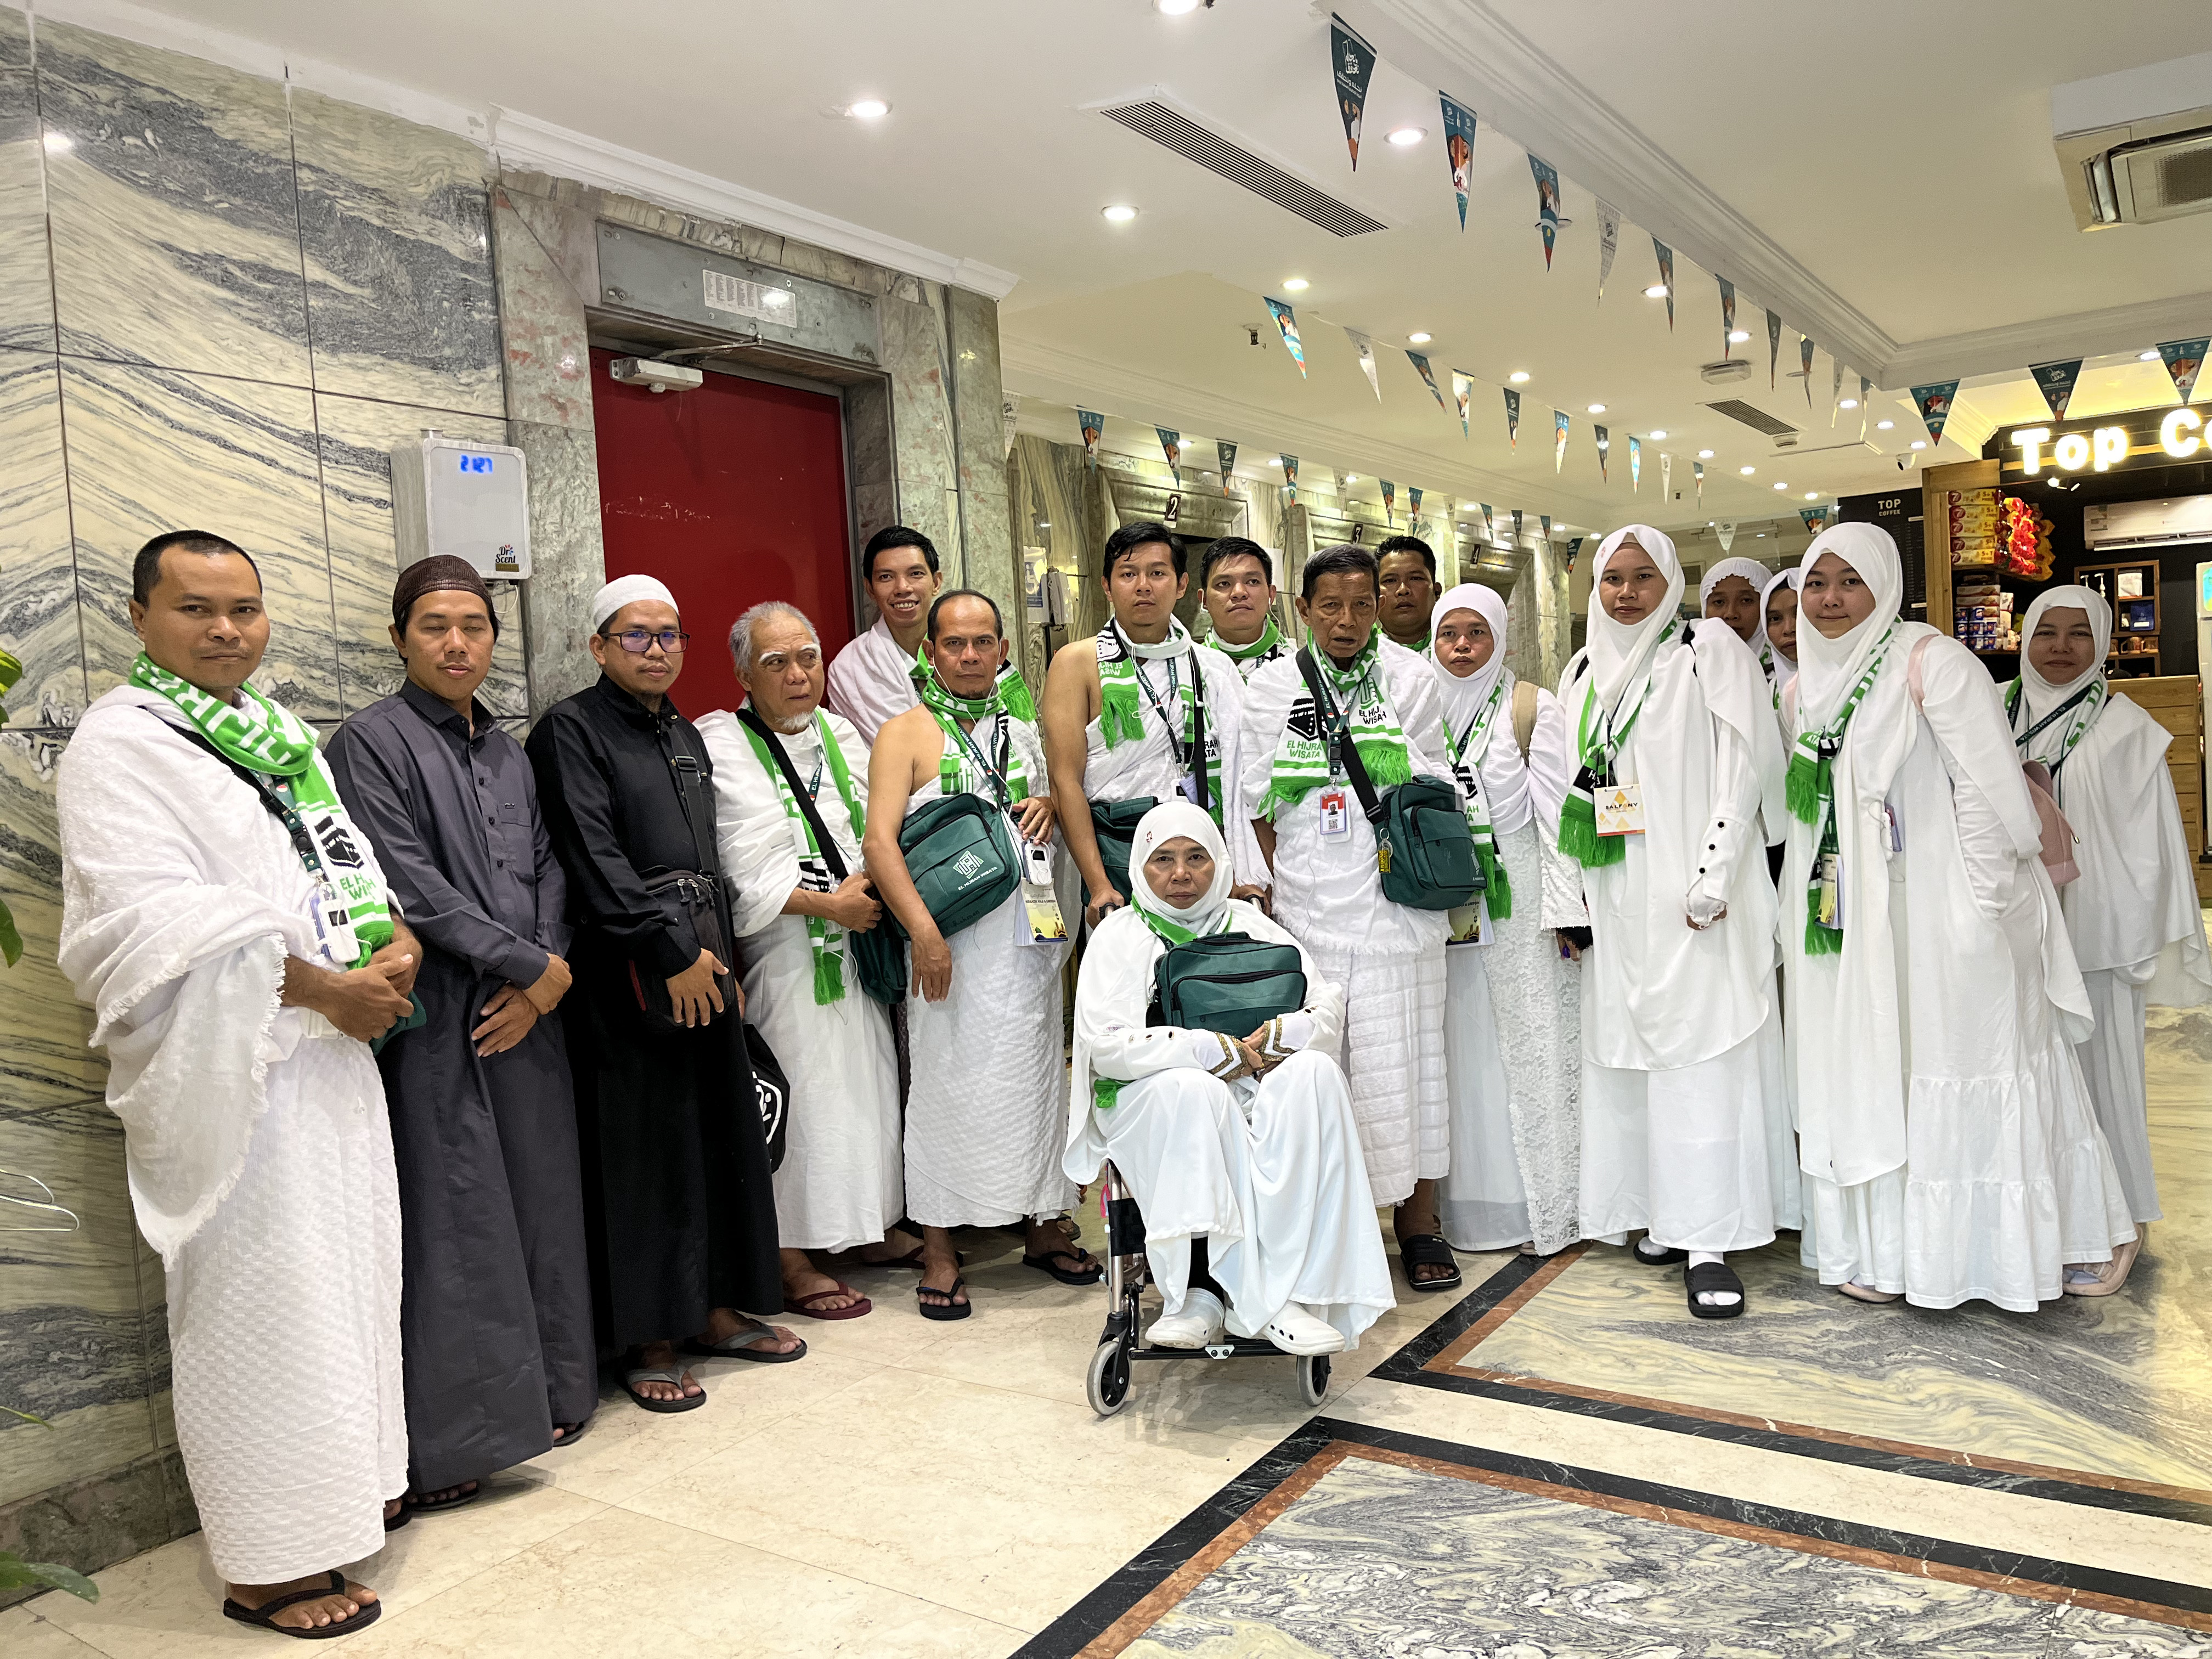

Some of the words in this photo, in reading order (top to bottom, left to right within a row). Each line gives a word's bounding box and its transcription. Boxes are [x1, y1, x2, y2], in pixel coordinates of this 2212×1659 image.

[2011, 426, 2129, 475] Top
[2159, 408, 2212, 460] C
[1167, 496, 1178, 519] 2
[1878, 499, 1901, 510] TOP
[1353, 527, 1361, 544] 3
[499, 546, 510, 556] Dr
[1473, 545, 1480, 563] 4
[495, 554, 516, 564] Scent
[142, 665, 291, 765] HIJRA
[1358, 709, 1367, 718] EL
[1286, 740, 1295, 748] EL
[1297, 740, 1322, 751] HIJRA
[1289, 748, 1321, 759] WISATA
[980, 866, 998, 877] WISATA
[339, 876, 354, 890] EL
